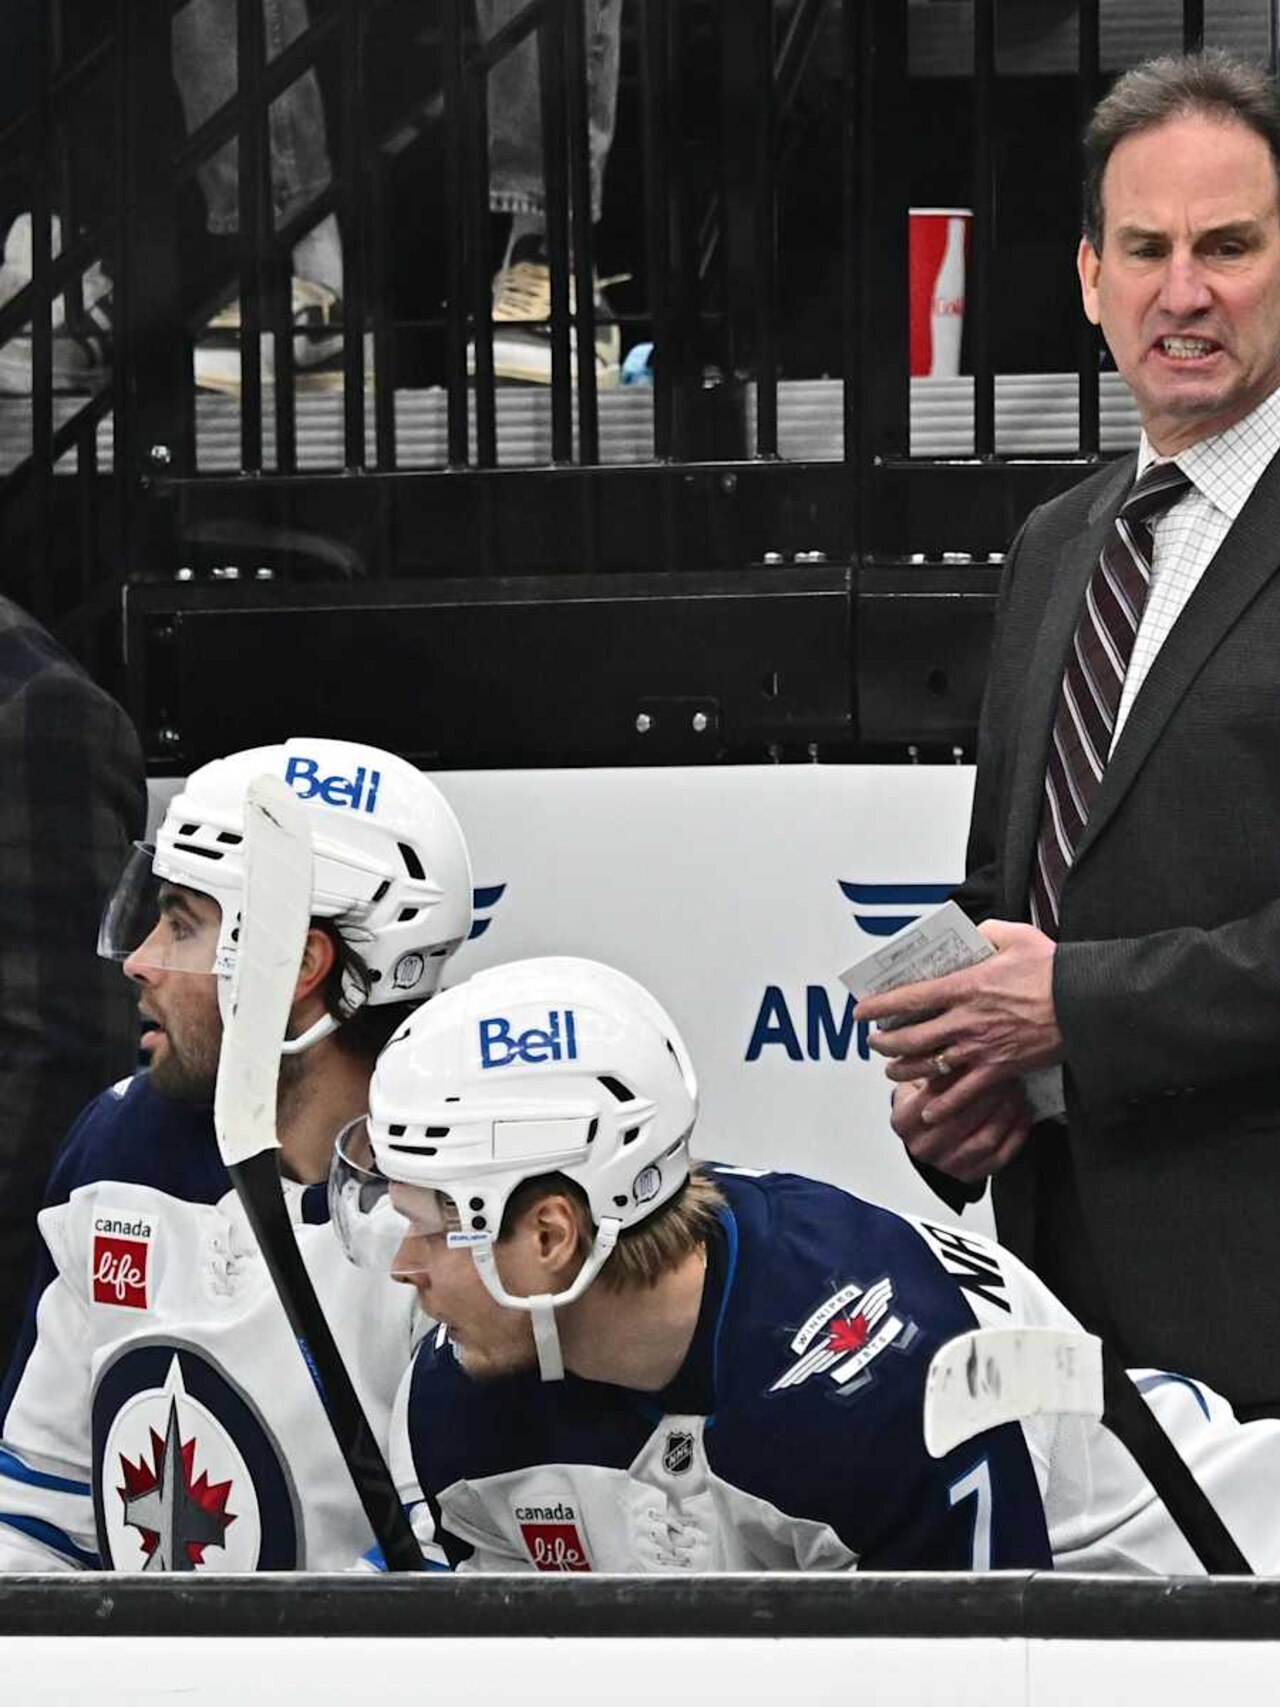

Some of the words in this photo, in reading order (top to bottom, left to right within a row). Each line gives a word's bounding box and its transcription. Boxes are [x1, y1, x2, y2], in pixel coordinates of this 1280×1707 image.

[285, 757, 380, 813] Bell
[478, 1010, 578, 1069] Bell
[745, 985, 870, 1061] AM
[95, 1218, 151, 1238] canada
[93, 1251, 147, 1300] life
[797, 1288, 856, 1347] WINNIPEG
[515, 1502, 575, 1521] canada
[532, 1537, 589, 1572] life
